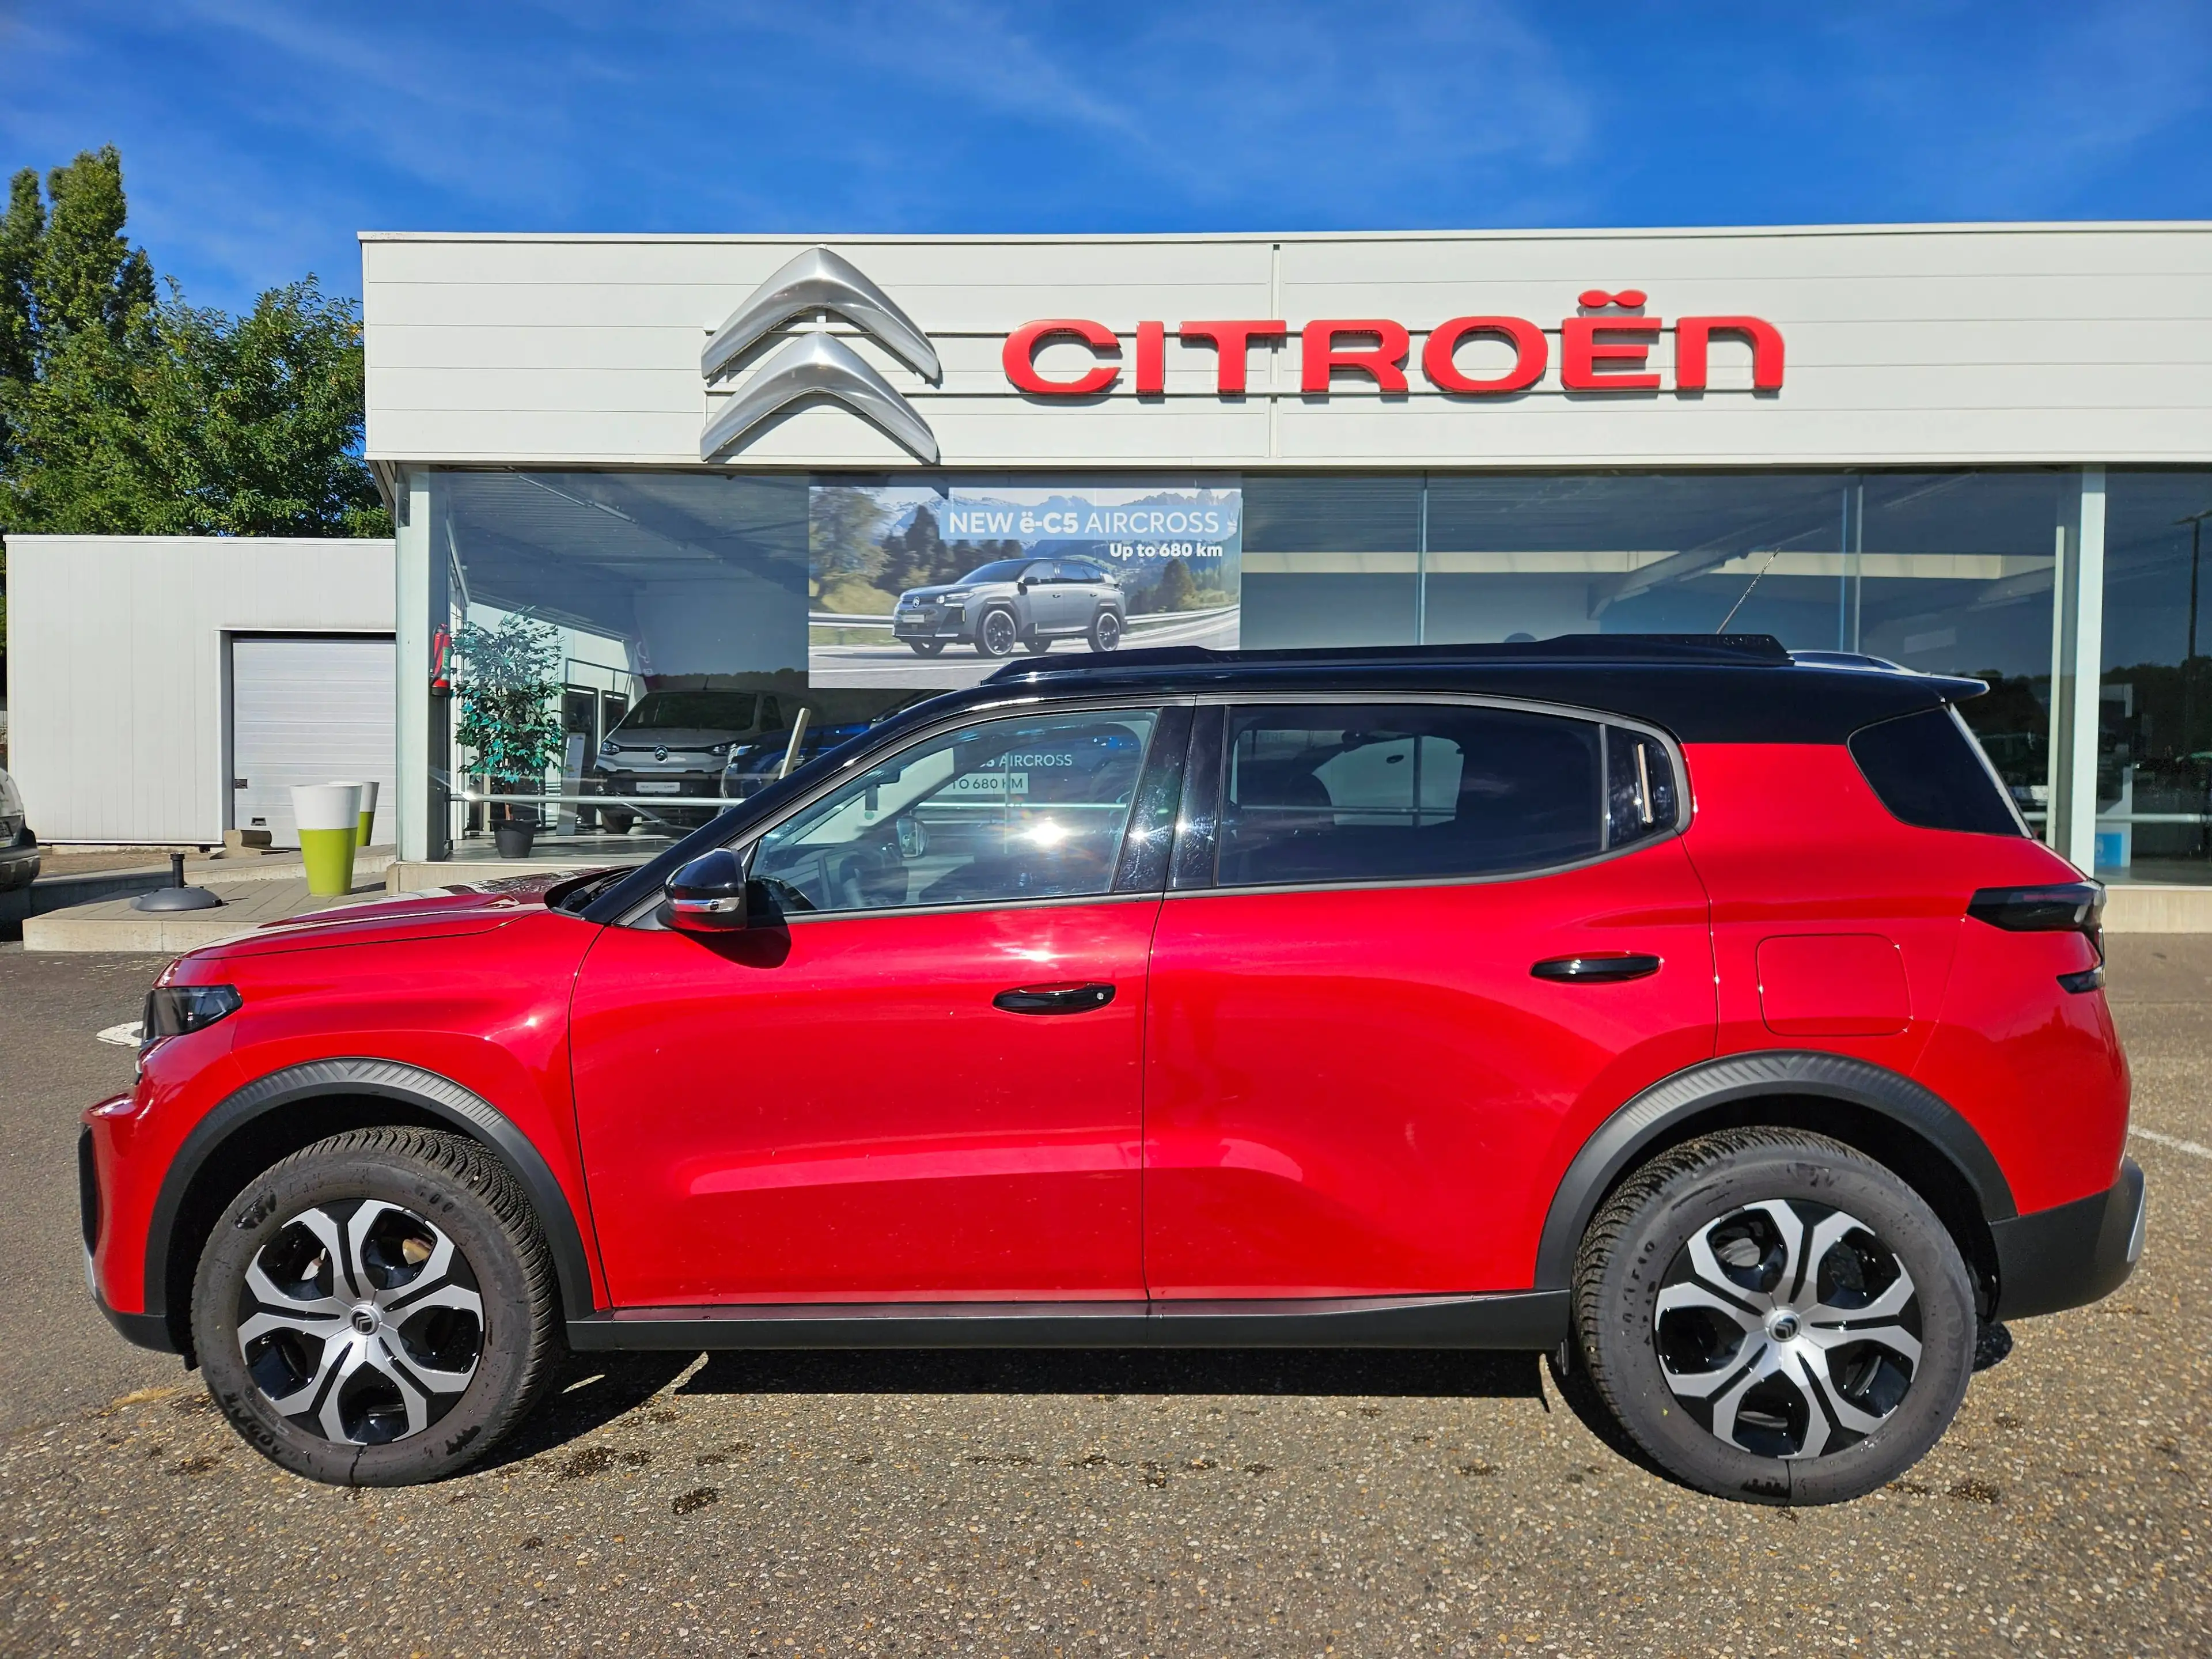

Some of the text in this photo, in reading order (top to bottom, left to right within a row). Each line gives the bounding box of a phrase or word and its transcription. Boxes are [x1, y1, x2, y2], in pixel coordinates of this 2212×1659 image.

[949, 511, 1219, 533] NEW ë-C5 AIRCROSS
[1109, 543, 1223, 561] Up to 680 km
[998, 754, 1073, 767] AIRCROSS
[972, 778, 998, 789] 680
